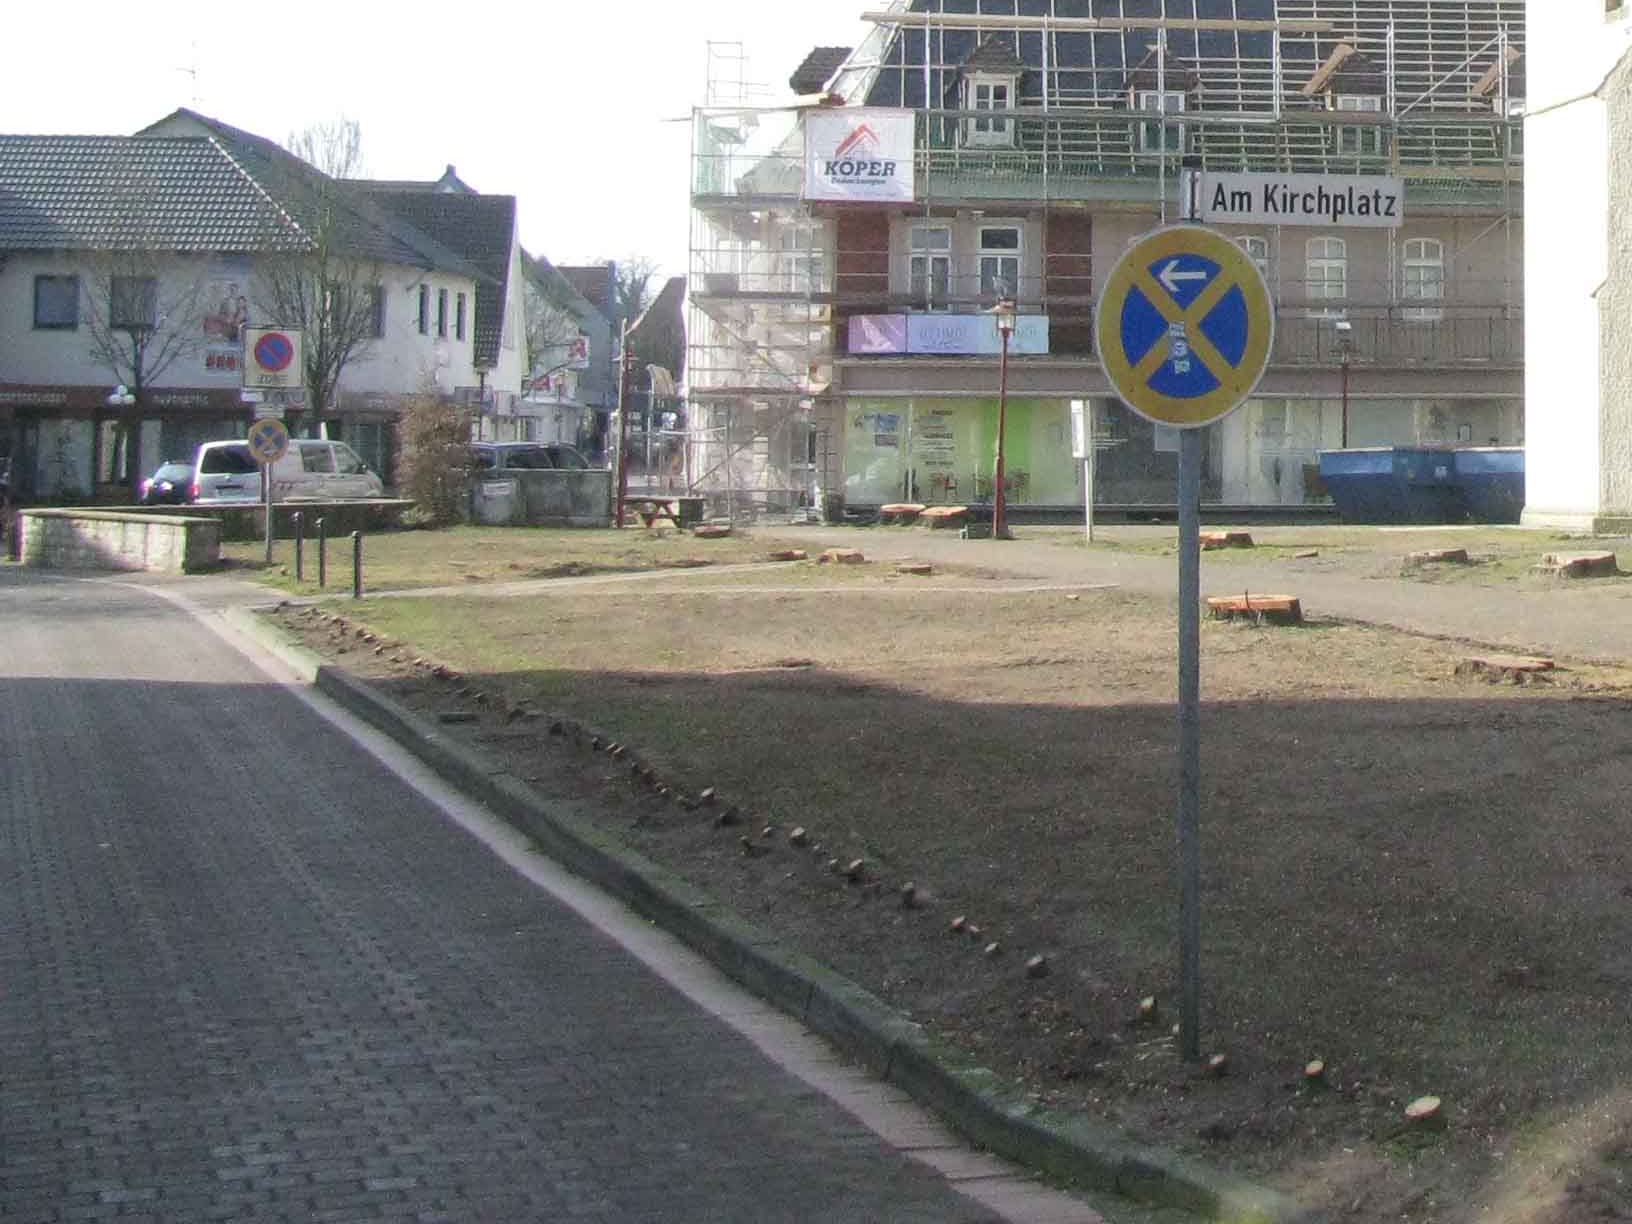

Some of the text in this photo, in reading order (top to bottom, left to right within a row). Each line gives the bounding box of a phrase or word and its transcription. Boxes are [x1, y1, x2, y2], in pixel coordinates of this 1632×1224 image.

[824, 157, 897, 176] KÖPER
[1211, 182, 1397, 223] Am Kirchplatz
[256, 374, 289, 385] ZOE
